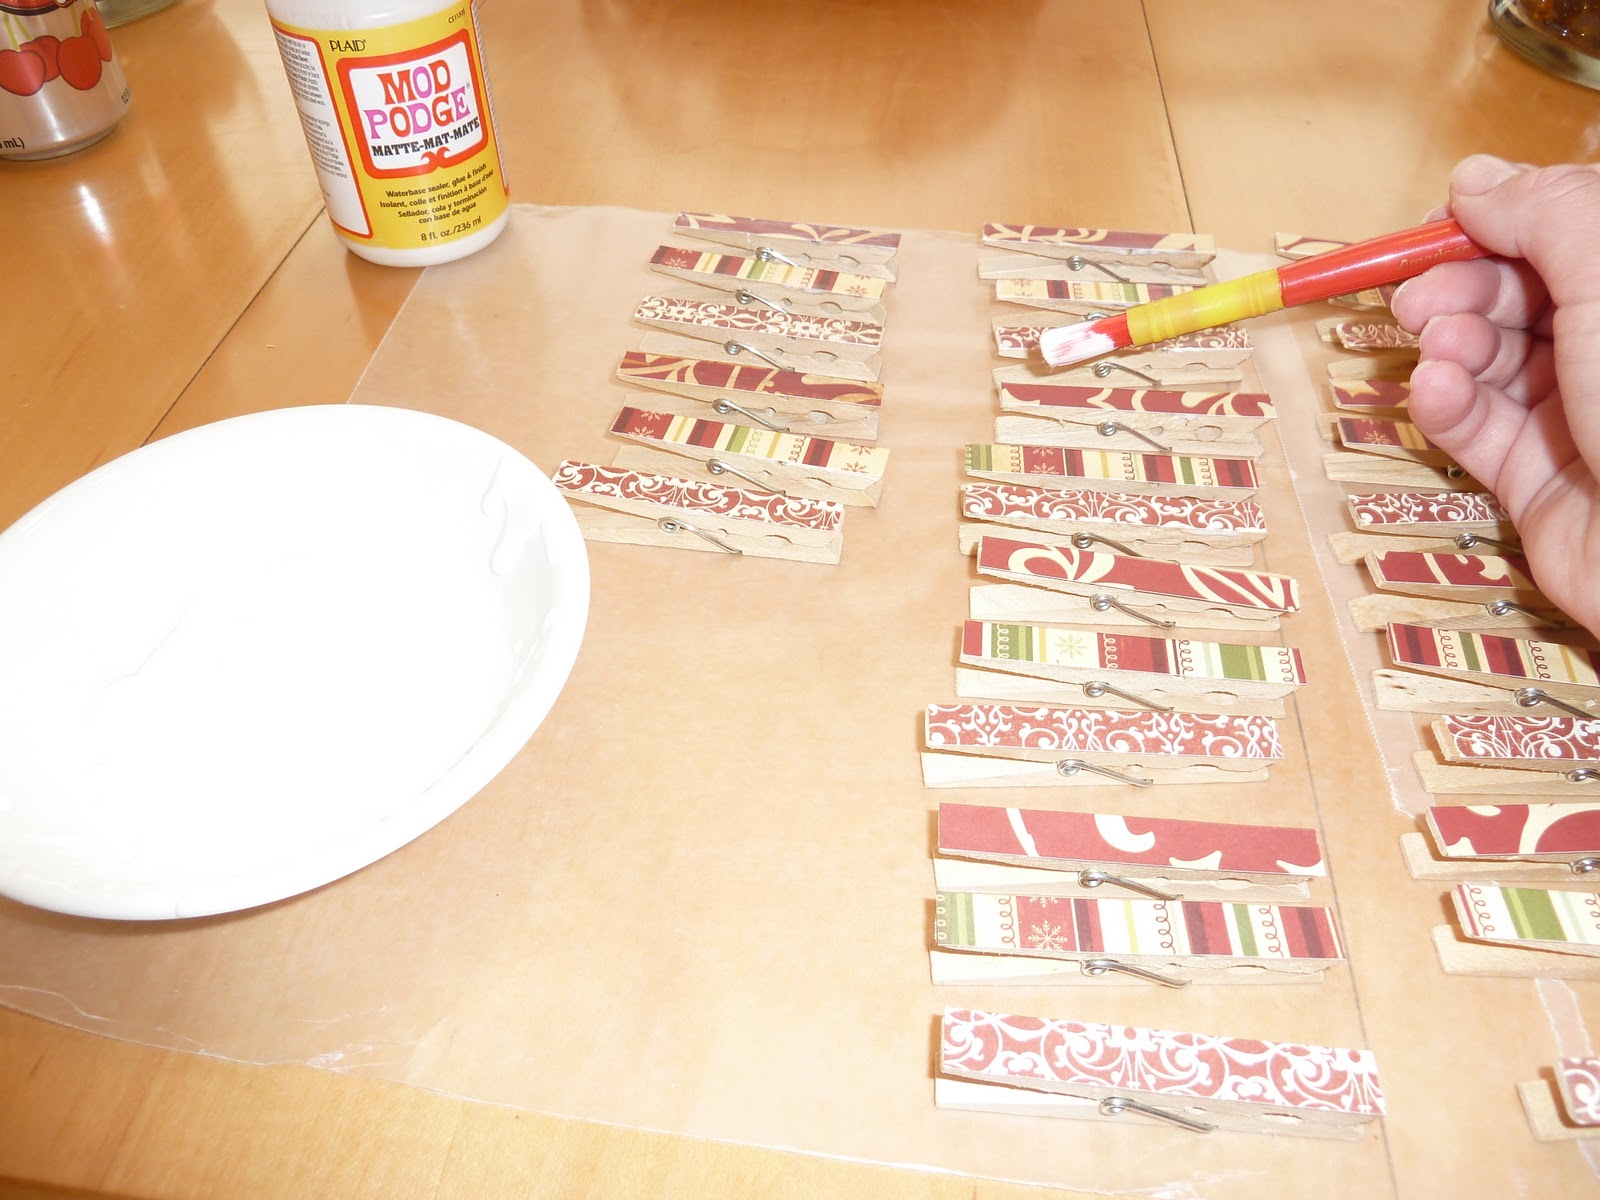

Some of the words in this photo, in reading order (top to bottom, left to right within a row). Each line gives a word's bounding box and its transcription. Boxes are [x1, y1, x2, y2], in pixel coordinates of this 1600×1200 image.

[329, 39, 366, 52] PLAID
[376, 59, 451, 105] MOD
[363, 86, 471, 139] PODGE
[371, 117, 480, 157] MATTE-MAT-MATE
[379, 201, 408, 209] Isolant,
[409, 198, 427, 207] colle
[437, 187, 463, 201] finition
[468, 178, 482, 190] base
[386, 188, 427, 198] Waterbase
[428, 182, 451, 193] sealer,
[452, 176, 466, 188] glue
[472, 163, 487, 176] finish
[398, 209, 430, 218] Sellador,
[431, 204, 446, 213] cola
[448, 202, 452, 211] y
[453, 186, 487, 206] terminación
[418, 215, 433, 224] con
[434, 211, 451, 221] base
[452, 207, 460, 216] de
[462, 201, 477, 213] agua
[420, 233, 427, 241] 8
[429, 231, 438, 240] fl.
[472, 215, 482, 226] ml
